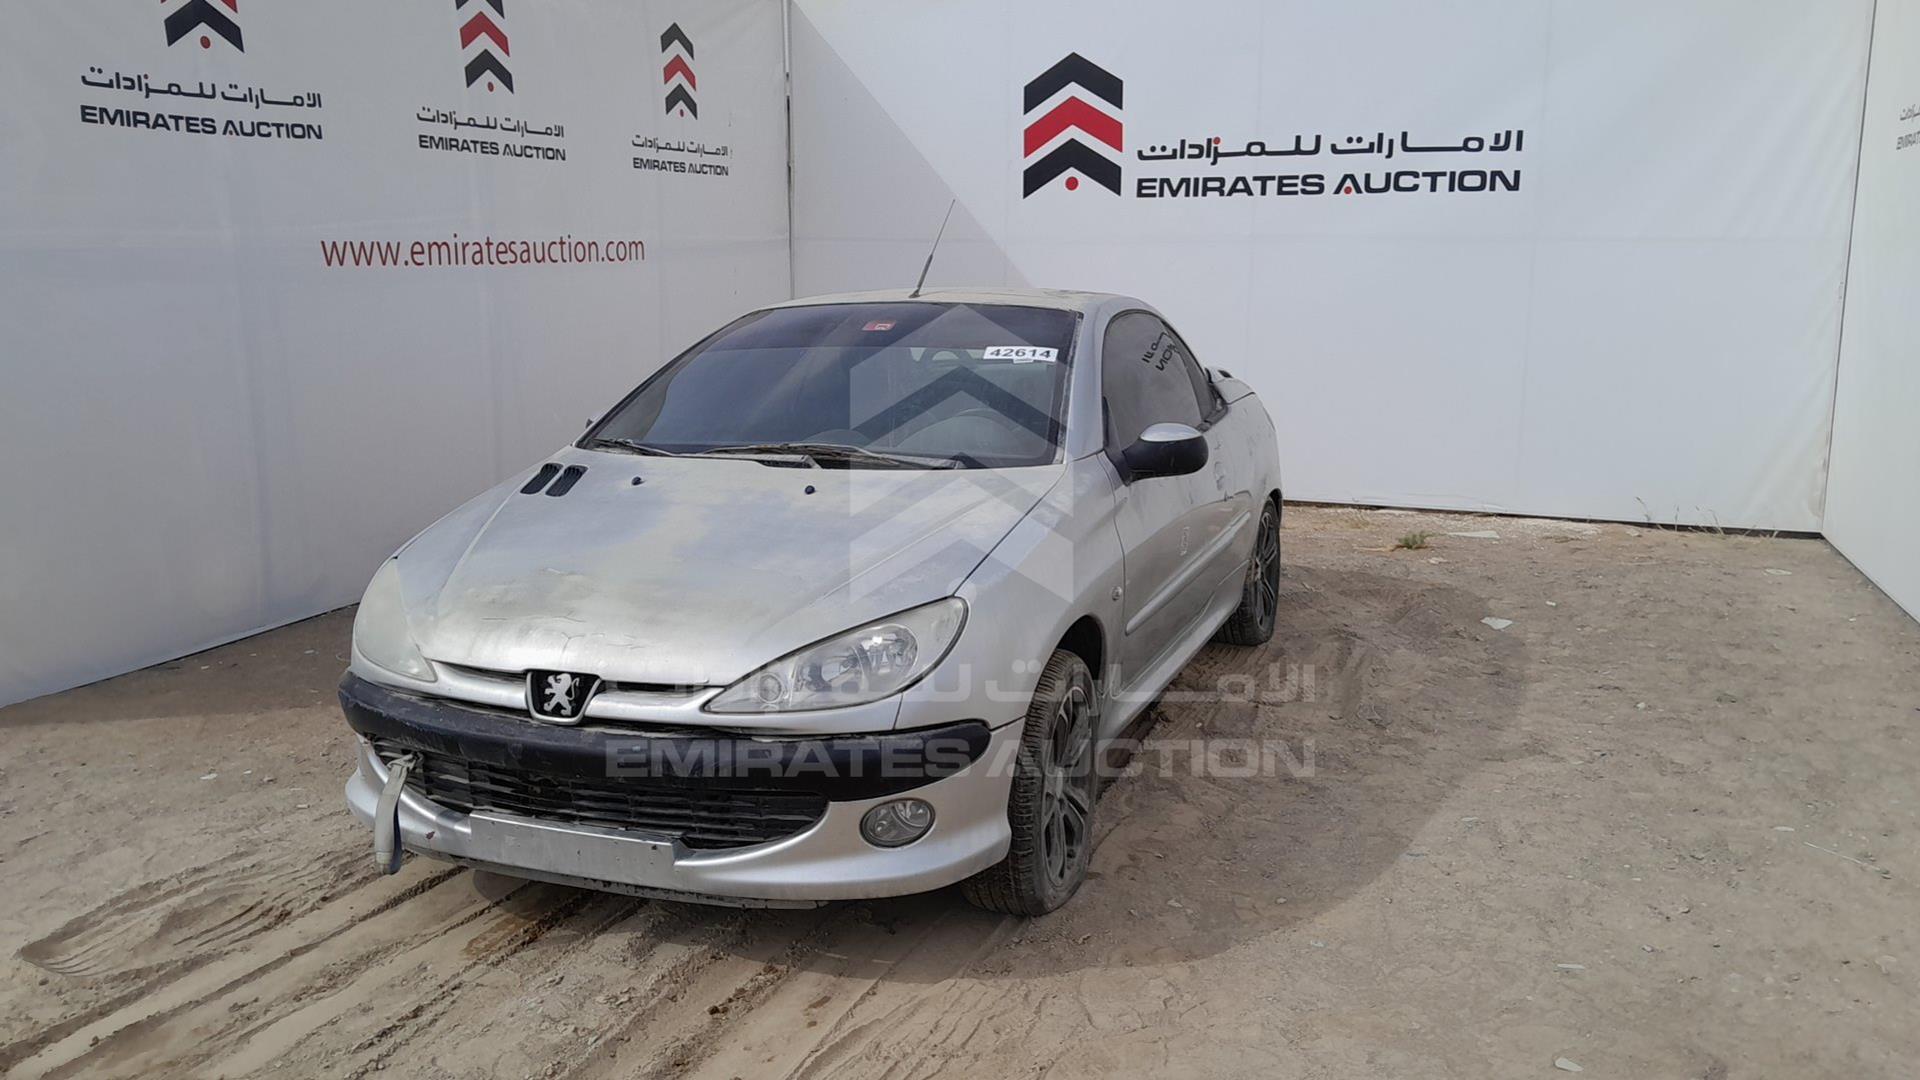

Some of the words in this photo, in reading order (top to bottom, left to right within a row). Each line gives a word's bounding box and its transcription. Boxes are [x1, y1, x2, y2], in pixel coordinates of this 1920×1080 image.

[80, 66, 216, 99] للمزادات
[221, 83, 323, 110] الامارات
[80, 105, 217, 135] EMIRATES
[222, 120, 323, 140] AUCTION
[418, 134, 499, 155] EMIRATES
[502, 143, 566, 162] AUCTION
[1137, 134, 1322, 166] للمزادات
[1330, 130, 1525, 160] الامارات
[633, 157, 686, 173] EMIRATES
[687, 162, 729, 176] AUCTION
[1136, 174, 1325, 198] EMIRATES
[1332, 170, 1521, 196] AUCTION
[320, 233, 646, 267] www.emiratesauction.com
[990, 348, 1051, 359] 42614
